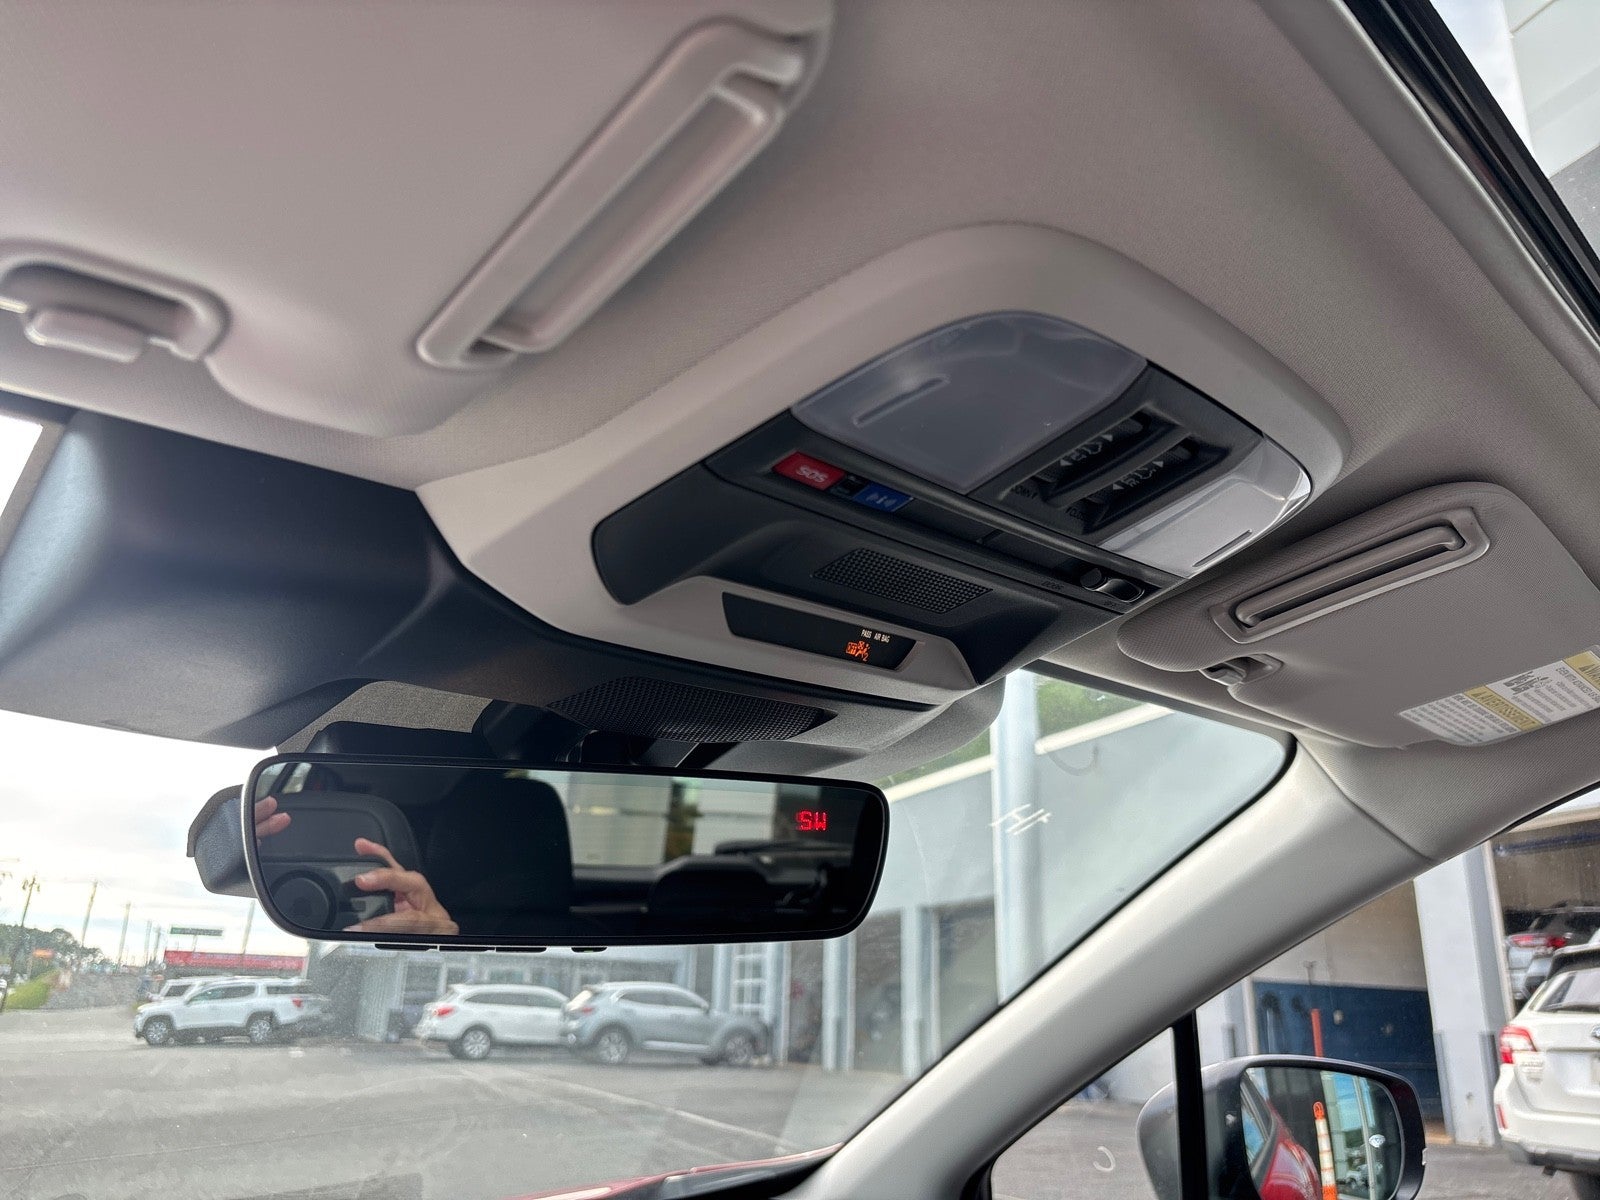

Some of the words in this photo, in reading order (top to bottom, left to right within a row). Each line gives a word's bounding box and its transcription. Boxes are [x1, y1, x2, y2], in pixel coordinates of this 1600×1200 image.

[796, 465, 829, 483] SOS
[861, 629, 872, 639] PASS
[881, 634, 891, 643] BAG
[796, 809, 828, 831] SW
